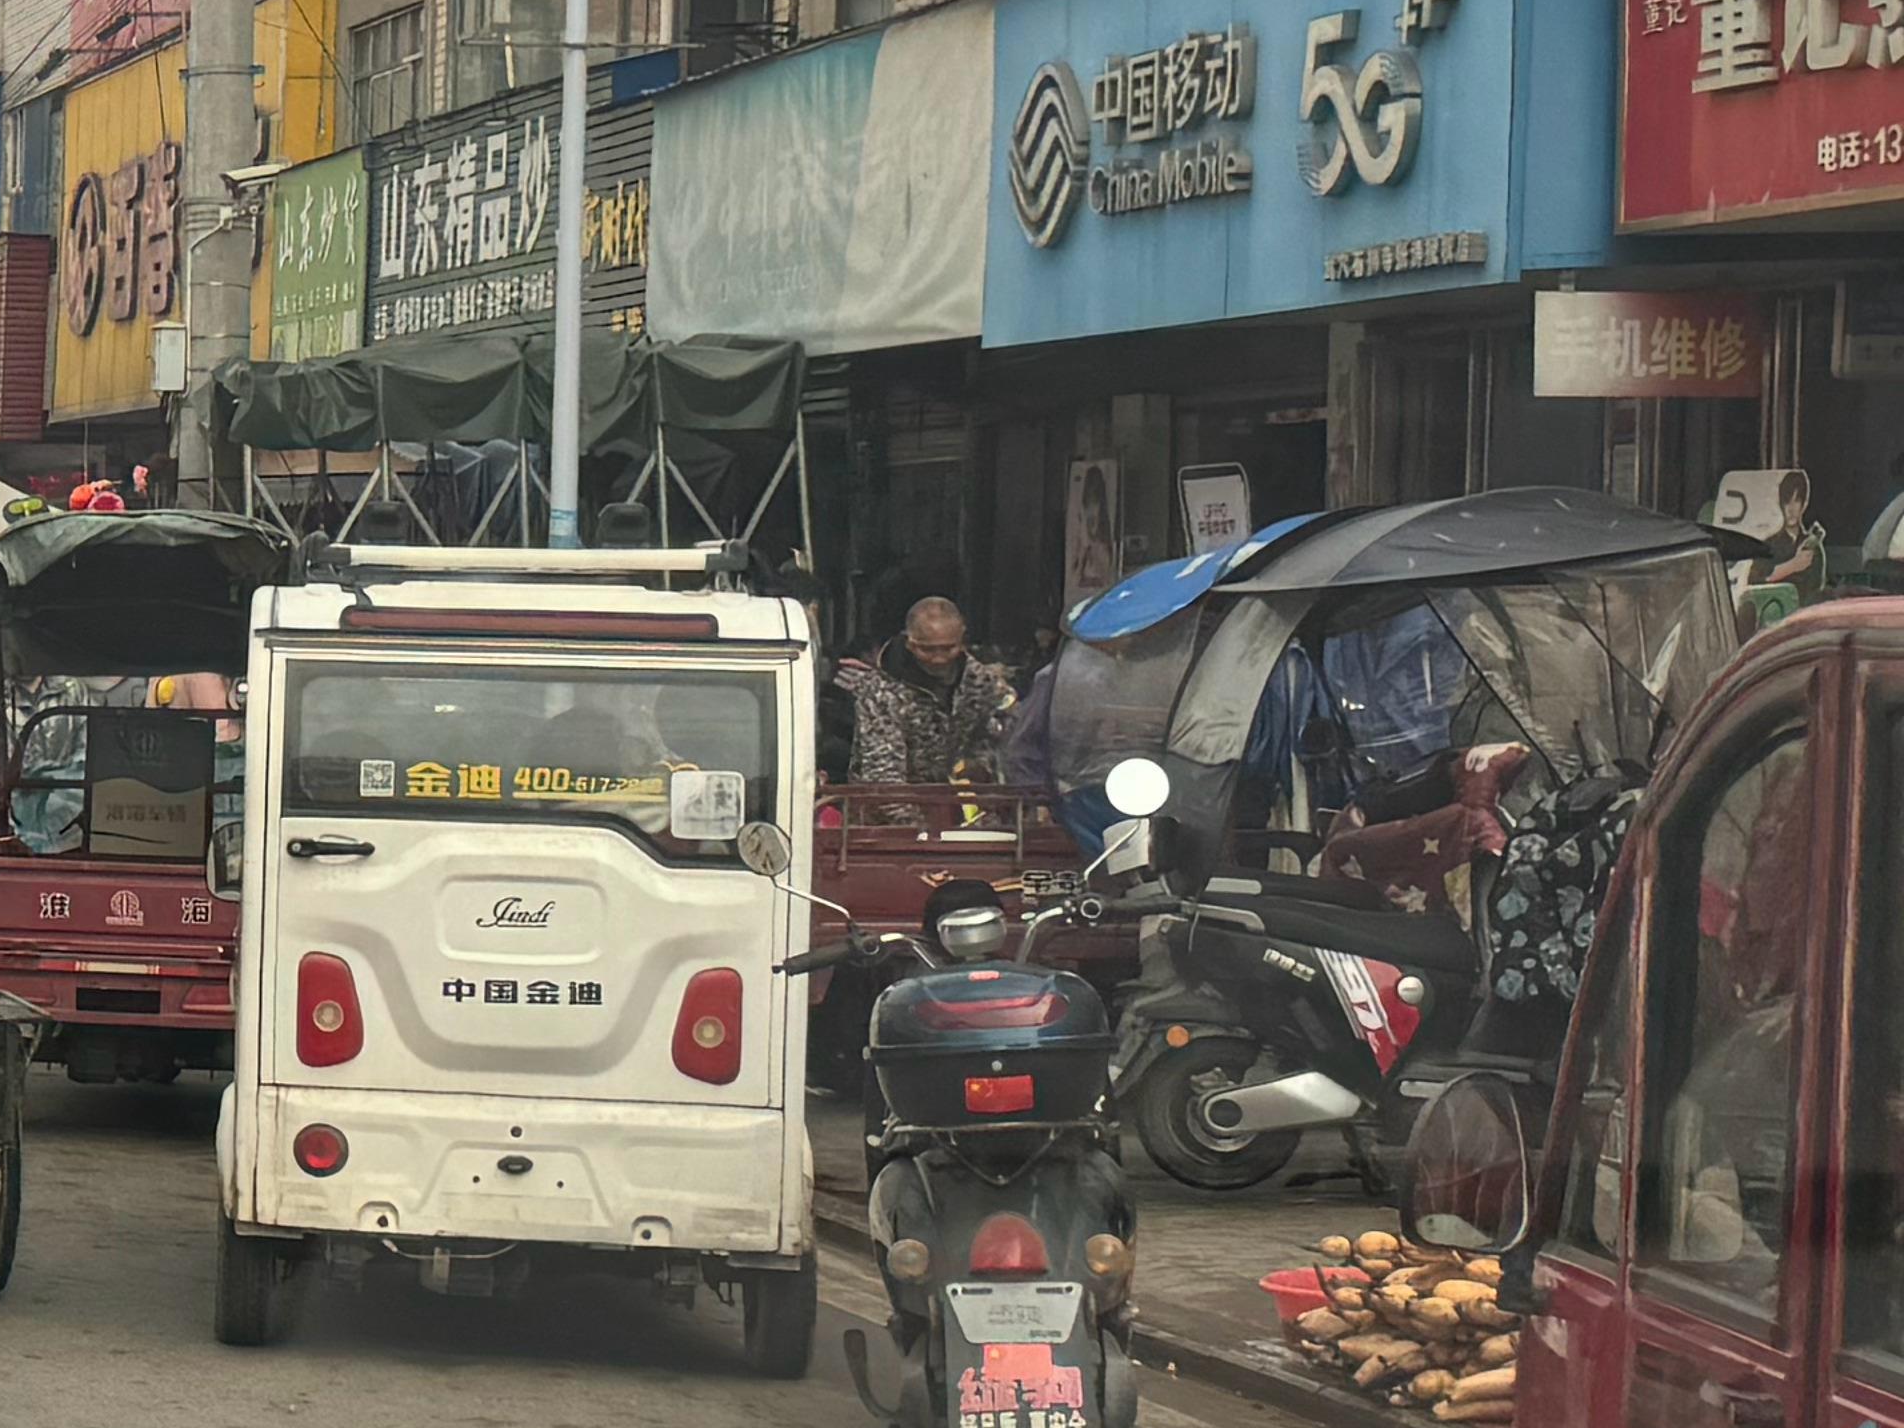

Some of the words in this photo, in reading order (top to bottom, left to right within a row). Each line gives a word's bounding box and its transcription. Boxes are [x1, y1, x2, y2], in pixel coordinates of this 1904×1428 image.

[1092, 22, 1256, 142] 中国移动
[1091, 160, 1155, 214] China
[1157, 138, 1248, 206] Mobile
[1553, 316, 1747, 382] 手机维修
[405, 761, 502, 800] 金迪
[475, 897, 556, 928] Jindi
[442, 977, 603, 1006] 中国金迪
